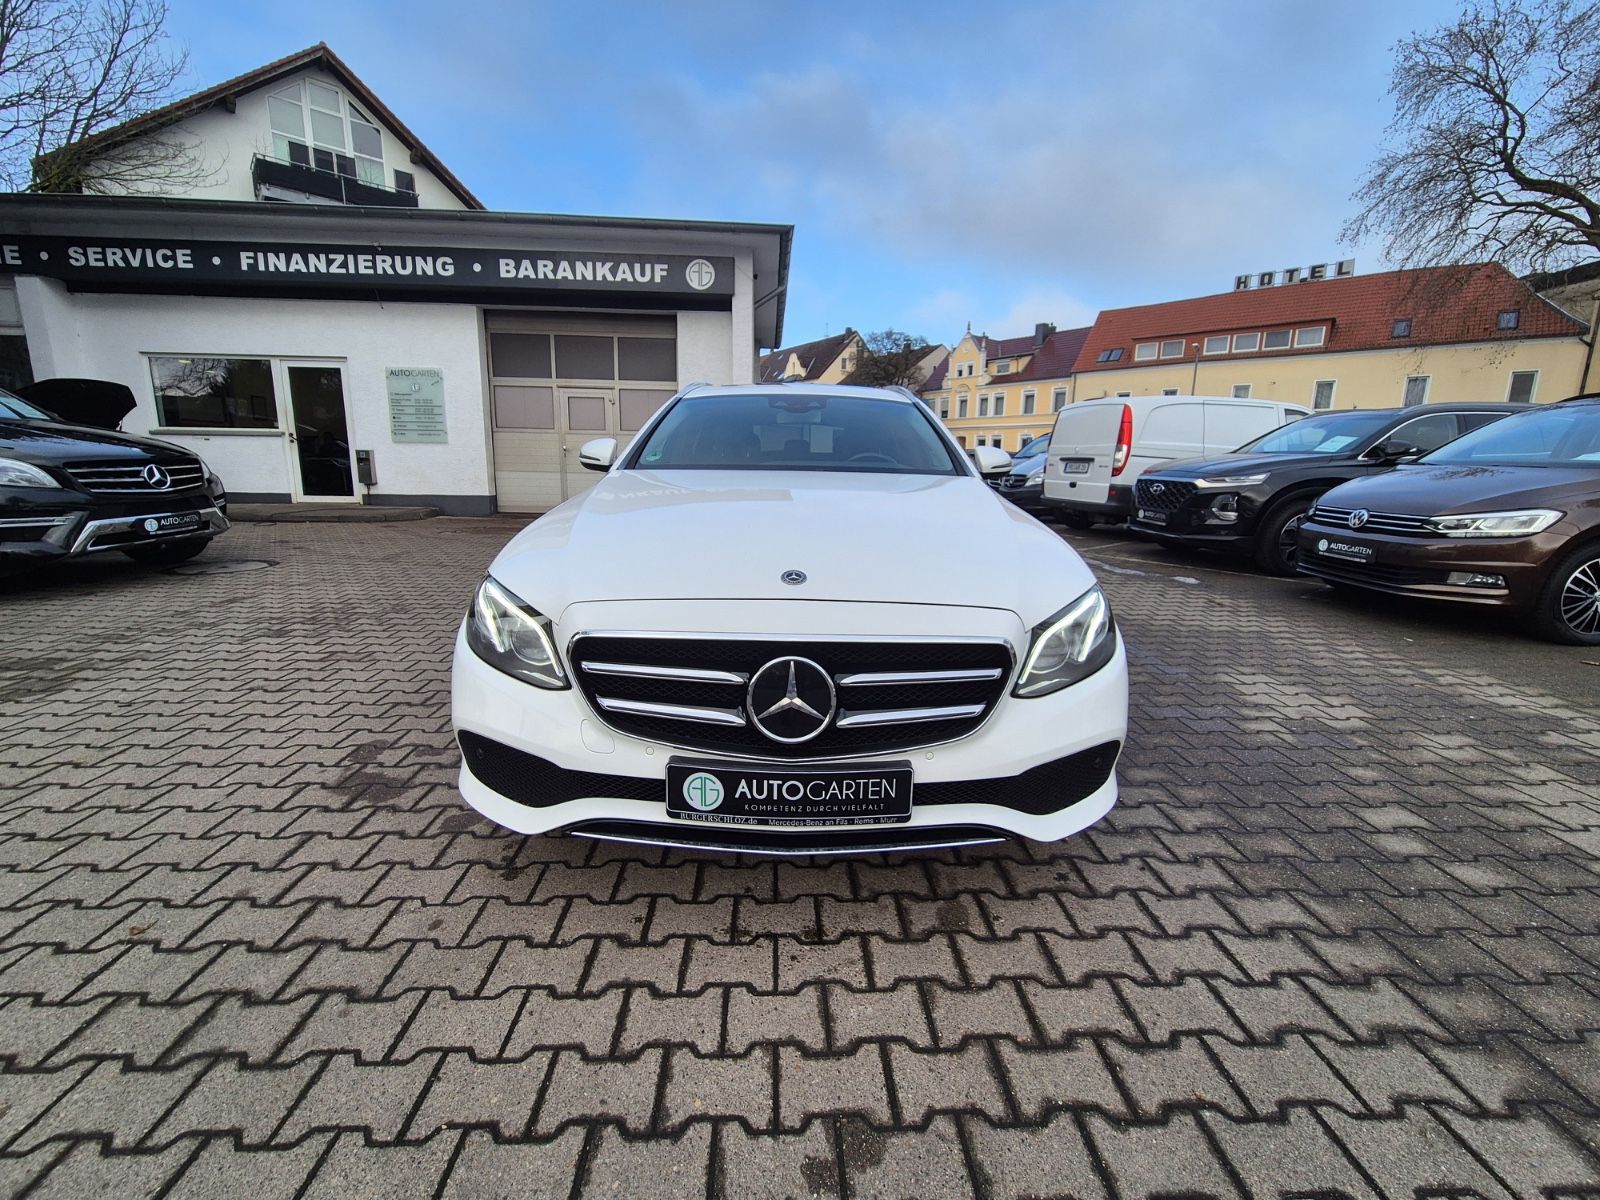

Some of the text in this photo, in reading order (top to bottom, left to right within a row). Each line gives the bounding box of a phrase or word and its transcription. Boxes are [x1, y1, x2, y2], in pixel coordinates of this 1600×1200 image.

[0, 245, 669, 283] E SERVICE FINANZIERUNG BARANKAUF
[1235, 261, 1352, 290] HOTEL
[389, 369, 440, 378] AUTOGARTEN
[160, 515, 198, 525] AUTOGARTEN
[1330, 542, 1372, 554] AUTOGARTEN
[734, 778, 897, 801] AUTOGARTEN
[744, 803, 885, 812] KOMPETENZ DURCH VIELFALT
[768, 819, 824, 827] Mercedes-Benz
[854, 817, 874, 825] Rems
[880, 816, 897, 824] Murr
